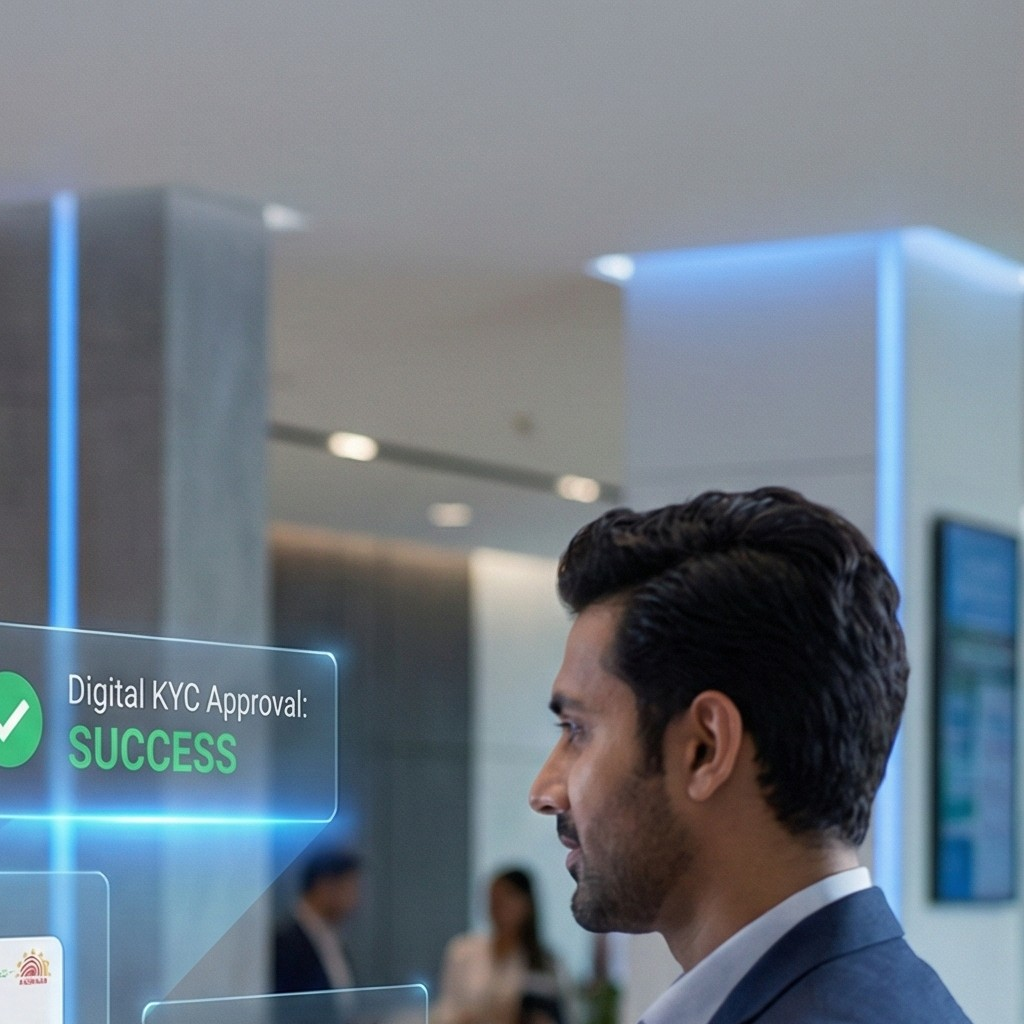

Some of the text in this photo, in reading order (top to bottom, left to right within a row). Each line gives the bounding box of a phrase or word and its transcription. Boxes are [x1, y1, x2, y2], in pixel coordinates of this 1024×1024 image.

[68, 674, 308, 722] Digital KYC Approval:
[68, 725, 237, 774] SUCCESS
